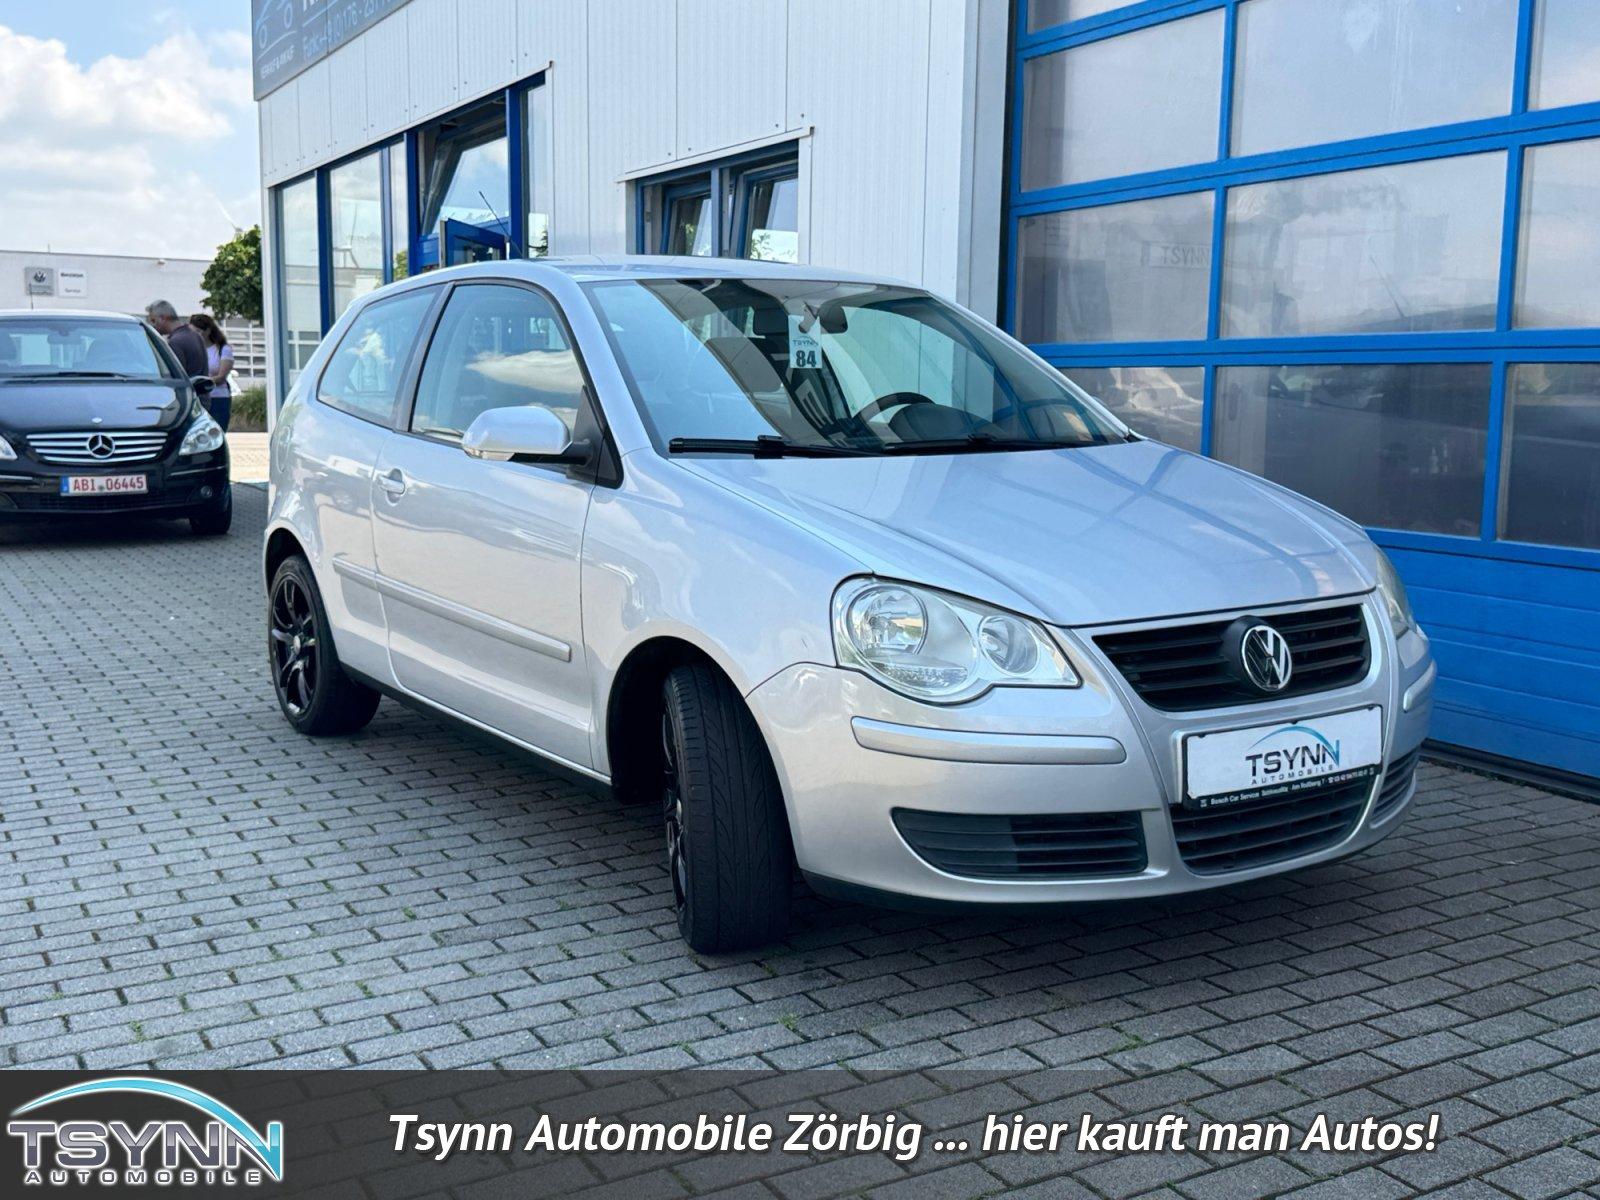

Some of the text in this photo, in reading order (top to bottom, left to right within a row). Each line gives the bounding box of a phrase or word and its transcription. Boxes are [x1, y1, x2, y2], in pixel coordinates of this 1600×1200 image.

[796, 350, 817, 367] 84
[105, 476, 144, 491] 06445
[1245, 739, 1340, 776] TSYNN
[1251, 764, 1334, 785] AUTOMOBILE
